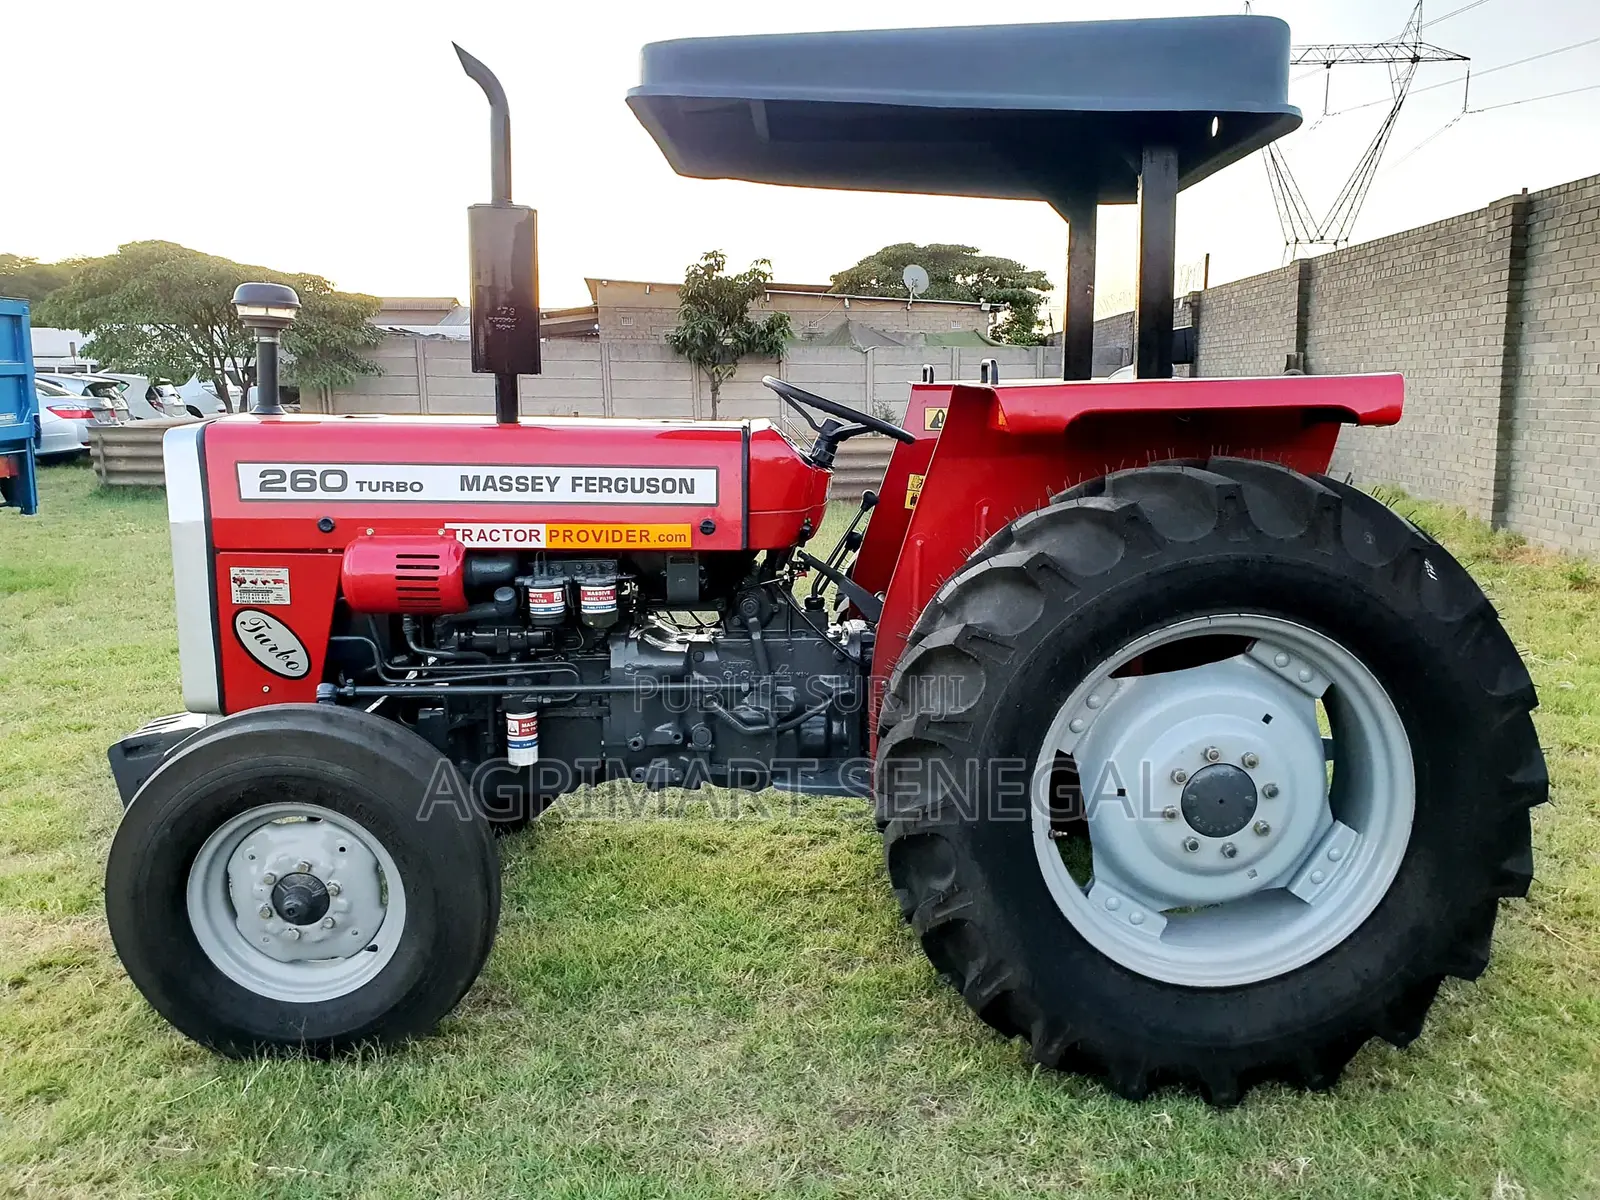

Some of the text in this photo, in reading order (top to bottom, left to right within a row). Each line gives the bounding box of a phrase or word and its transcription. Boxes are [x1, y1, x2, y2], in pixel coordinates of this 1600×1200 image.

[258, 469, 695, 495] 260 TURBO MASSEY FERGUSON
[240, 617, 304, 672] Turbo
